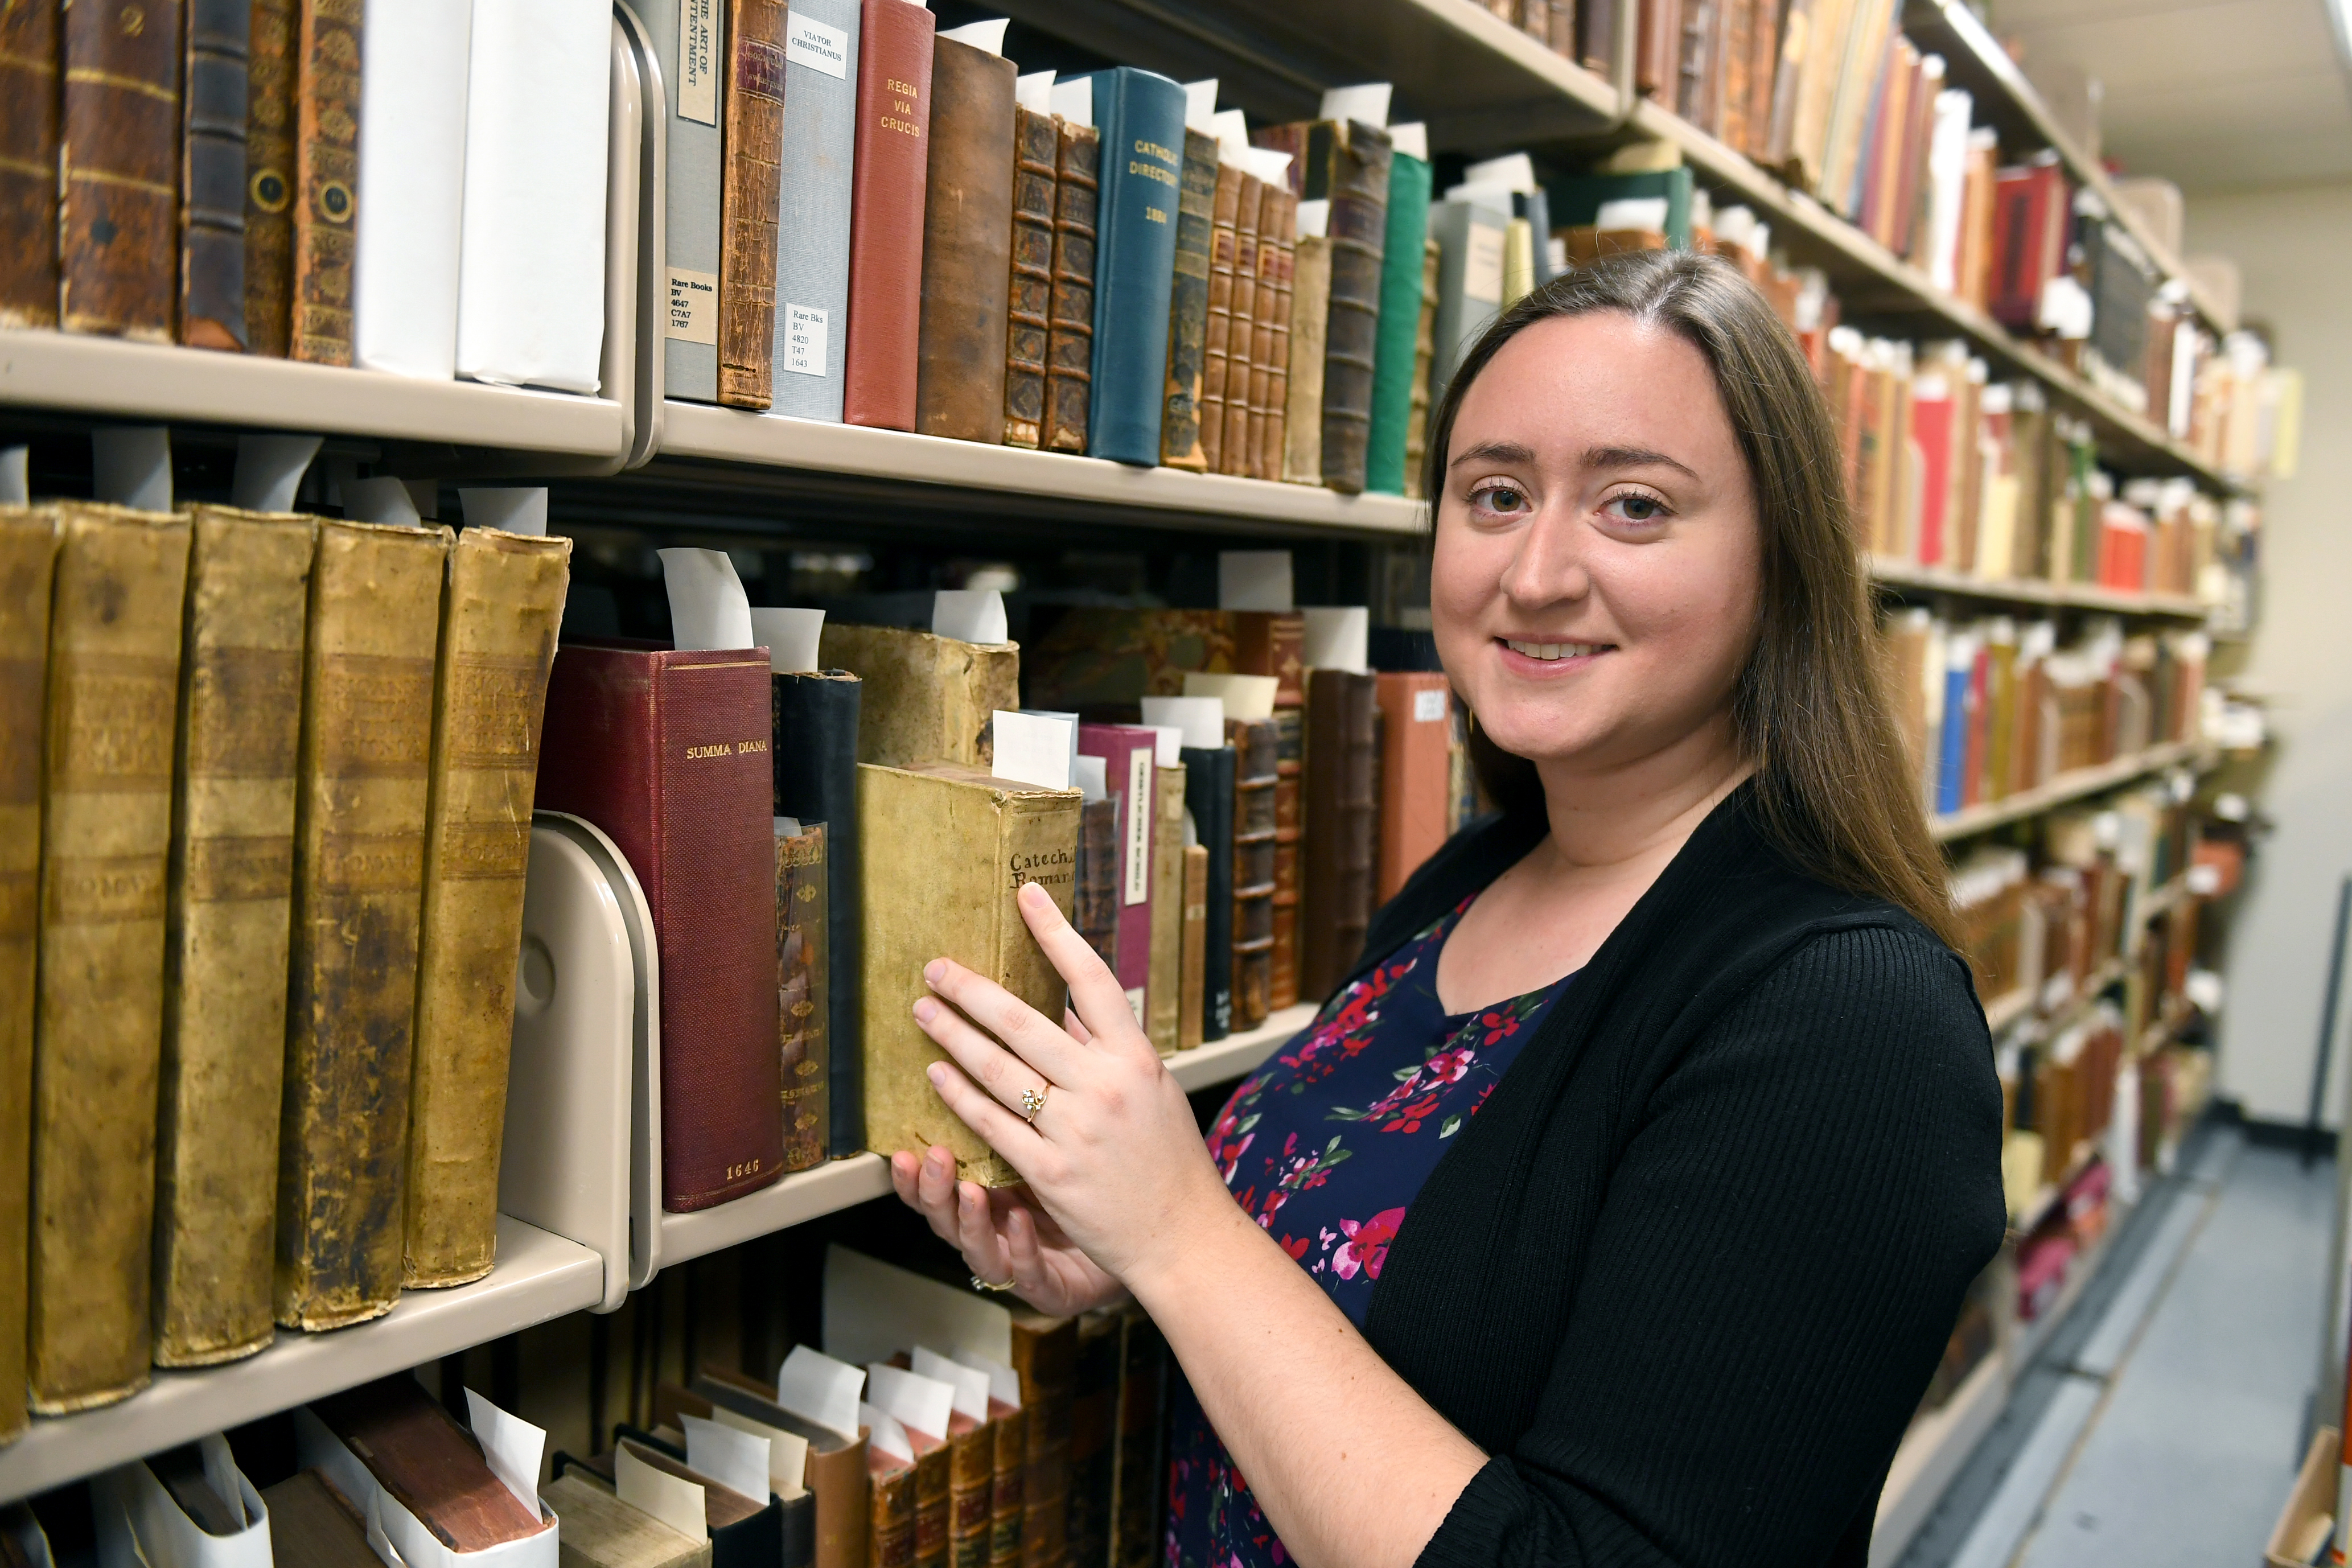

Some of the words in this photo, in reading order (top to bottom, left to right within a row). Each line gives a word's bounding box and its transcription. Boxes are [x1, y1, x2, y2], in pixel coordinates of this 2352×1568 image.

[804, 30, 832, 47] VIATOR
[792, 38, 841, 61] CHRISTIANUS
[700, 55, 708, 75] OF
[887, 79, 918, 98] REGIA
[894, 100, 911, 115] VIA
[881, 116, 920, 137] CRUCIS
[672, 278, 688, 287] Rare
[690, 282, 712, 292] Books
[671, 299, 689, 308] 4647
[671, 309, 691, 318] C7A7
[793, 310, 808, 320] Rare
[811, 314, 823, 323] Bks
[672, 319, 689, 328] 1767
[793, 322, 804, 331] BV
[792, 335, 809, 344] 4820
[792, 346, 804, 355] T47
[792, 358, 807, 368] 1643
[686, 743, 732, 759] SUMMA
[739, 740, 767, 754] DIANA
[727, 1158, 759, 1180] 1646
